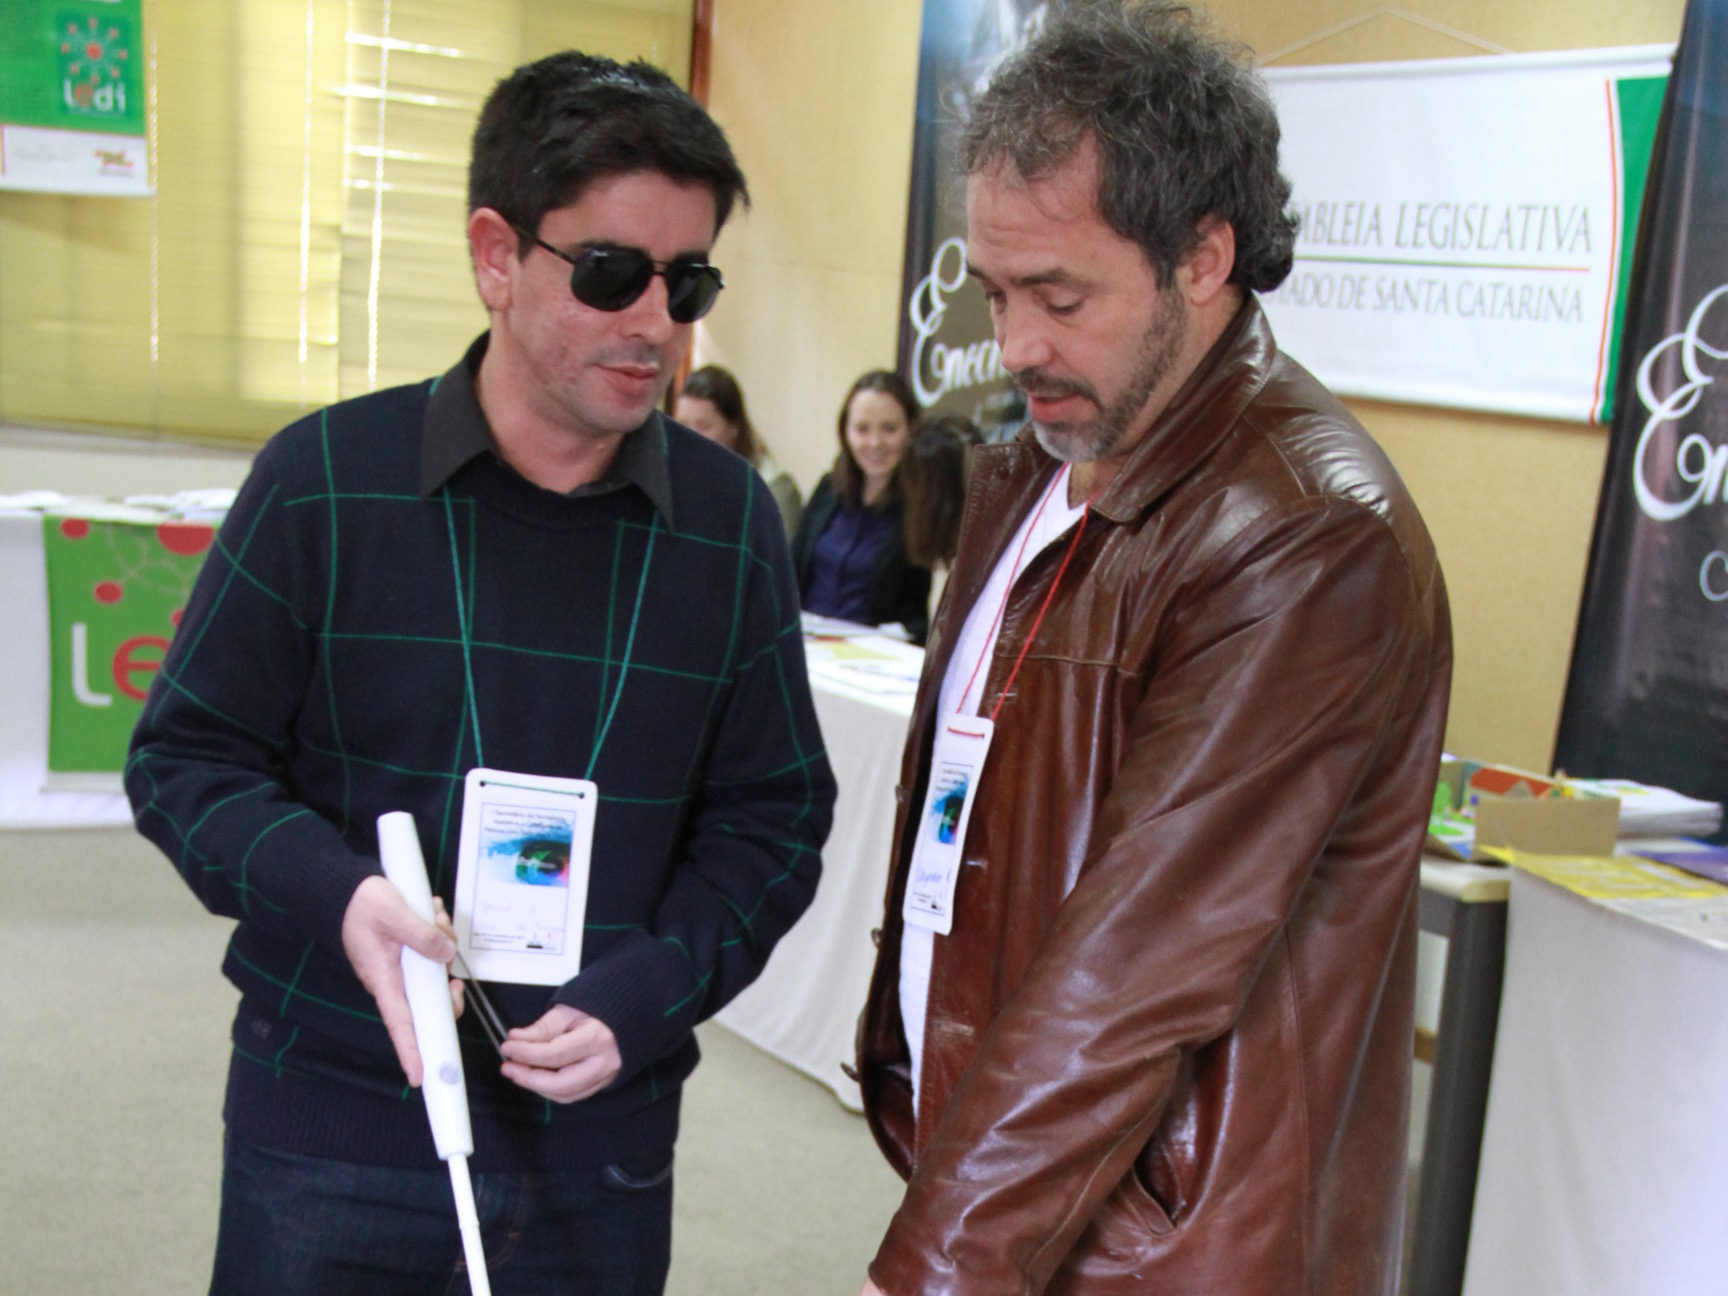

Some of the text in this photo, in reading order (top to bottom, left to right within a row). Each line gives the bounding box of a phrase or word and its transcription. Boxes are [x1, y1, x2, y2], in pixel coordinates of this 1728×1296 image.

[1394, 201, 1592, 252] LEGISLATIVA
[1336, 273, 1369, 310] DE
[1372, 275, 1449, 315] SANTA
[1456, 279, 1583, 323] CATARINA
